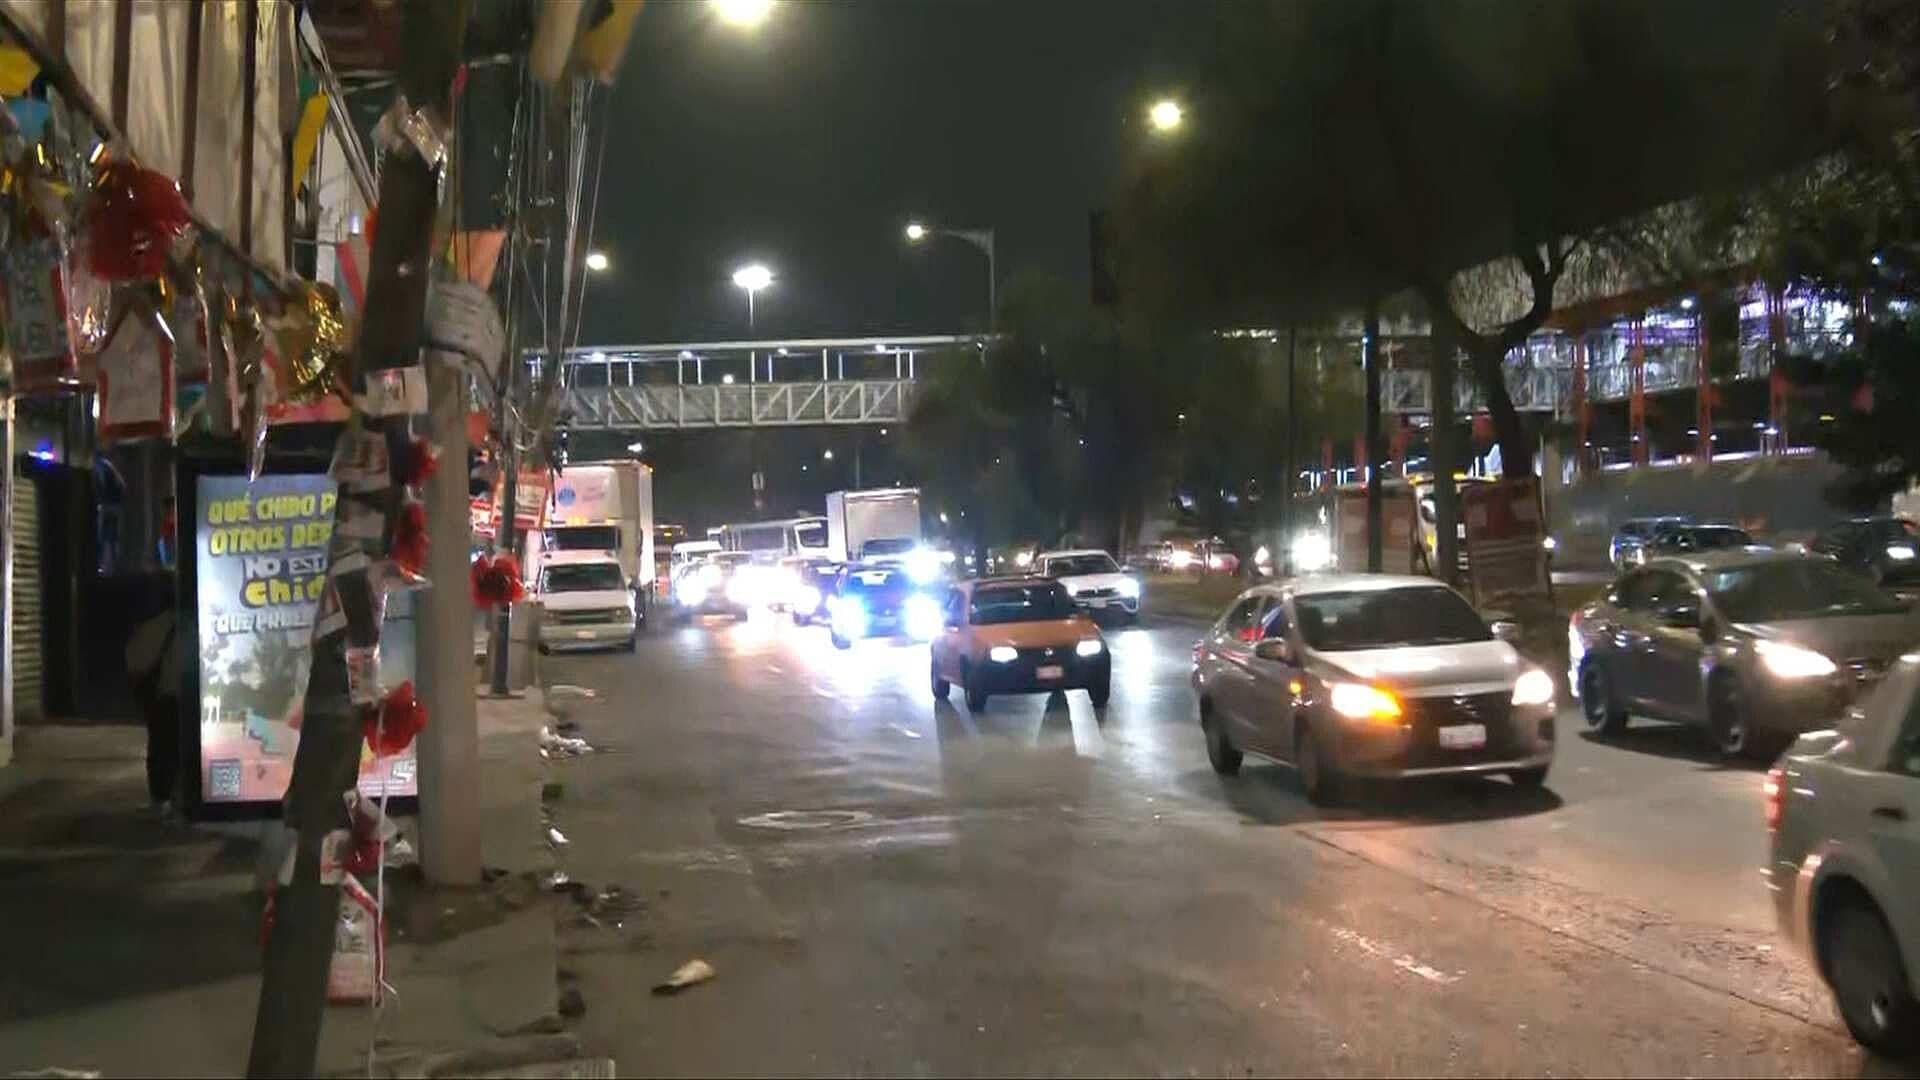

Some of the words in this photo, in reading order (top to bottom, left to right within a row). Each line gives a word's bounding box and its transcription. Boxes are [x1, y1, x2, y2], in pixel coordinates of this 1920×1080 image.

[256, 495, 316, 520] CHIDO
[211, 524, 285, 555] OTROS
[245, 556, 281, 577] NO
